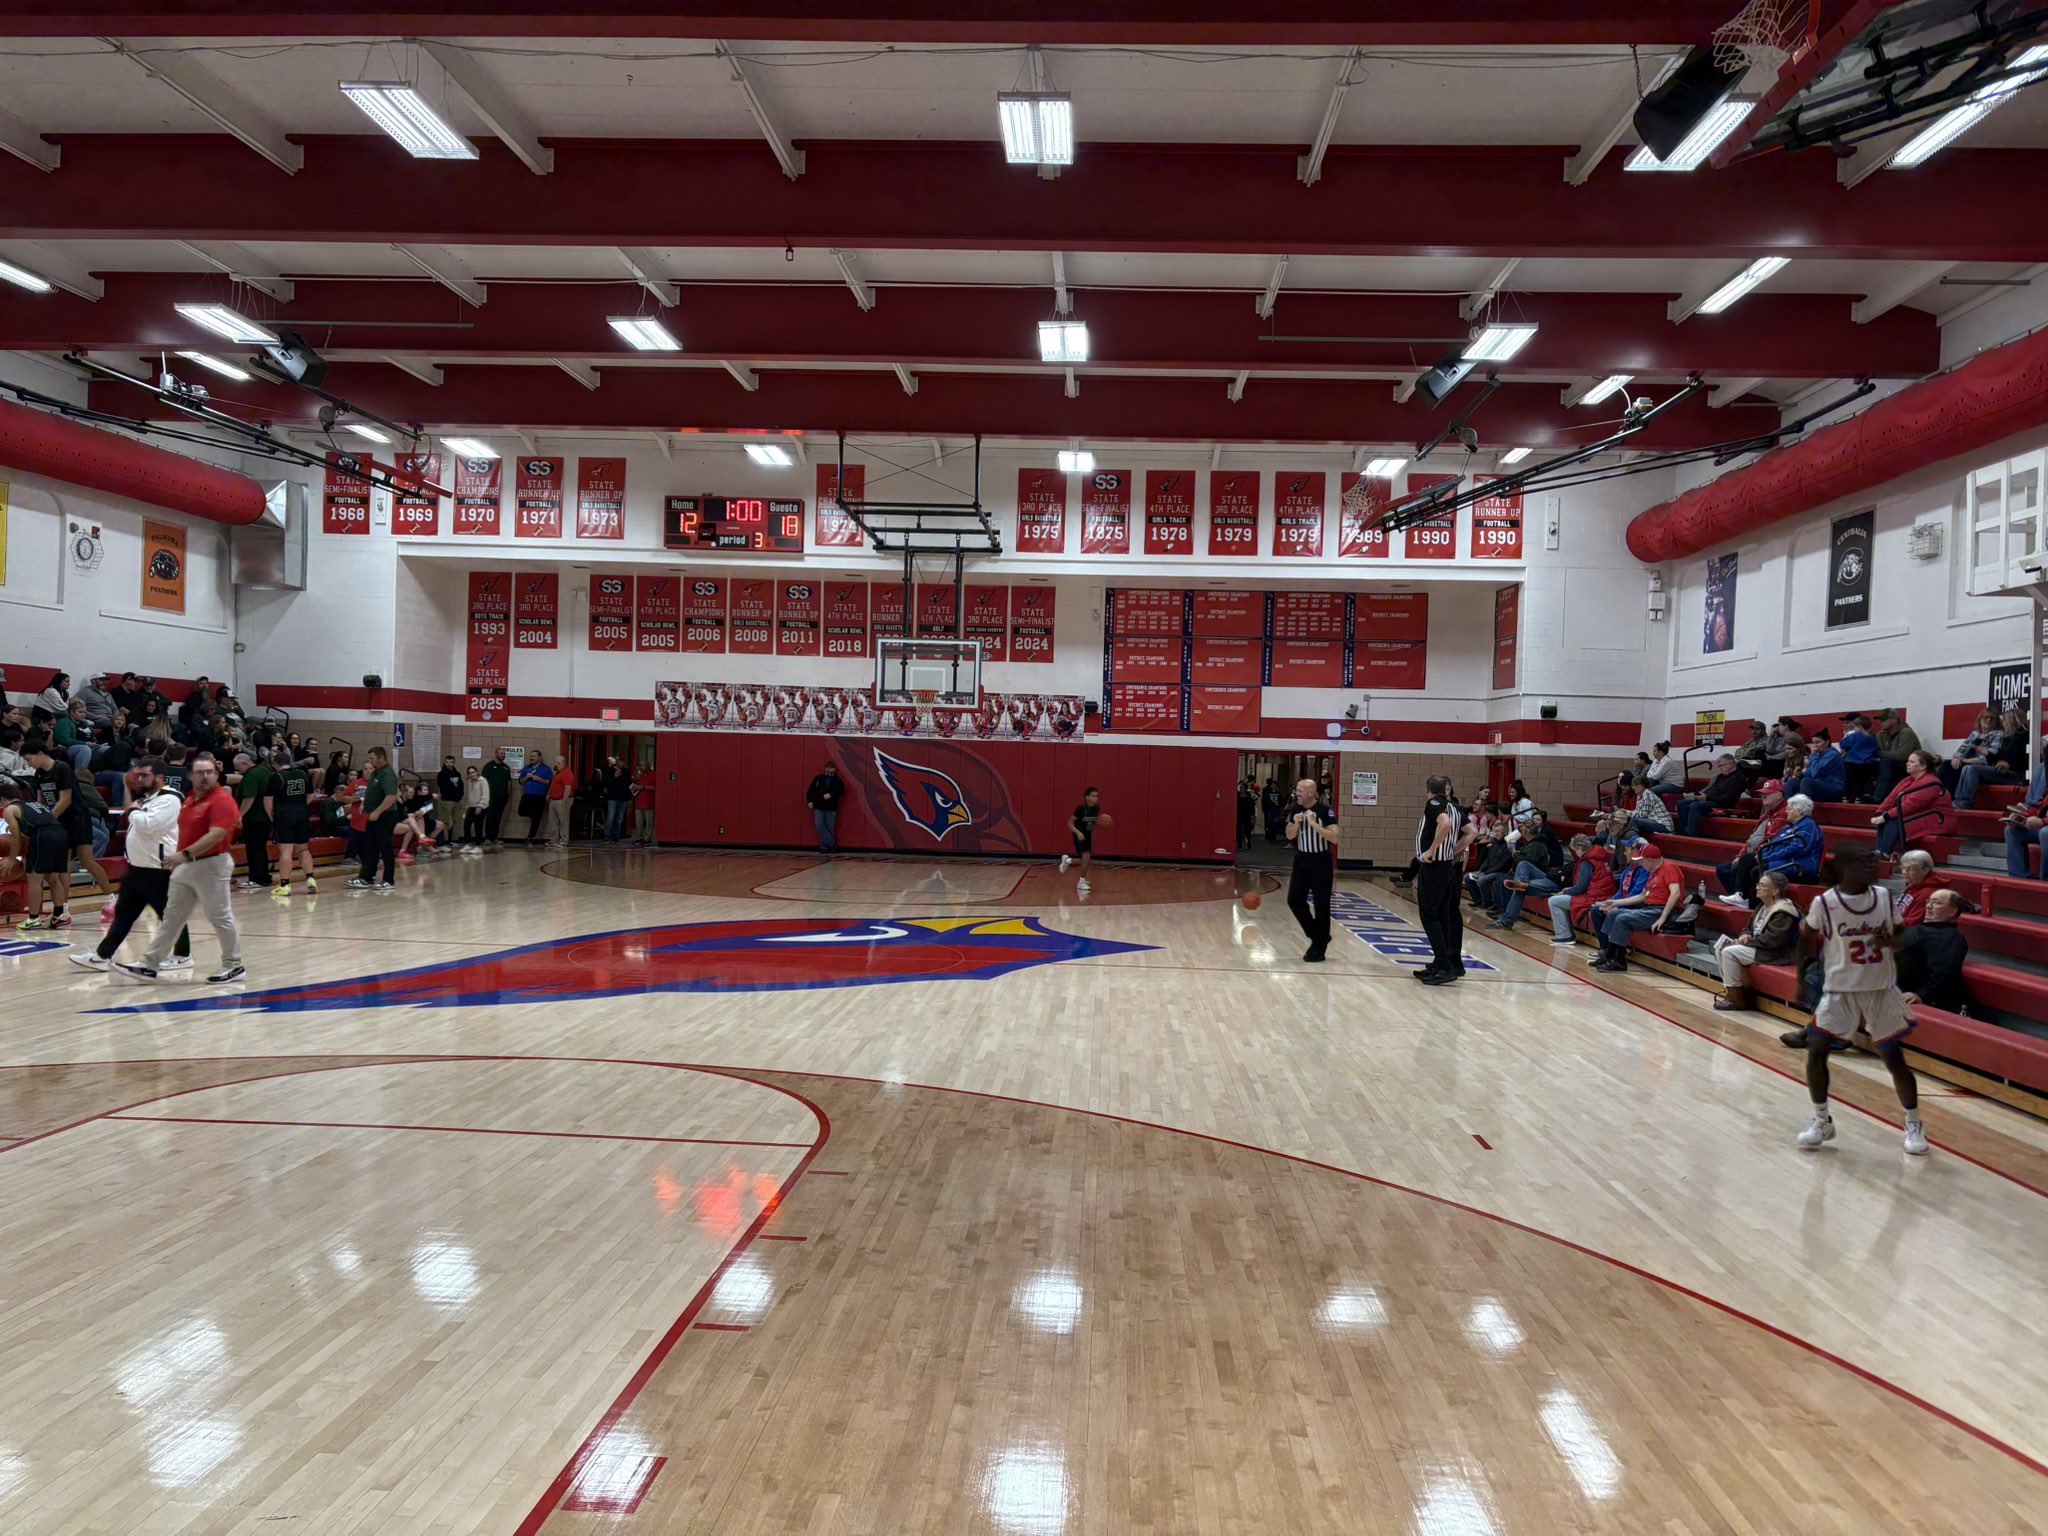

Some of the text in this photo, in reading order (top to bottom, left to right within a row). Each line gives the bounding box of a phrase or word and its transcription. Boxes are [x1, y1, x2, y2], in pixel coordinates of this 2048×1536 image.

[335, 475, 361, 484] STATE
[465, 477, 490, 485] STATE
[527, 480, 552, 488] STATE
[324, 485, 370, 494] SEMI-FINALIST
[589, 481, 614, 489] STATE
[456, 486, 499, 496] CHAMPIONS
[518, 489, 561, 498] RUNNER UP
[580, 490, 624, 499] RUNNER UP
[827, 487, 853, 497] STTE
[1029, 493, 1055, 502] STATE
[1093, 494, 1119, 503] STATE
[1157, 495, 1183, 503] STATE
[1221, 496, 1247, 504] STATE
[1286, 497, 1312, 505] STATE
[671, 500, 694, 509] Home
[769, 502, 798, 513] Guests
[1021, 503, 1061, 512] 3RD PLACE
[1081, 504, 1130, 512] SEMI-FINALIST
[1484, 499, 1511, 507] STATE
[726, 500, 762, 522] 1:00
[1150, 504, 1189, 513] 4TH PLACE
[1215, 505, 1253, 514] 3RD PLACE
[1278, 506, 1320, 515] 4TH PLACE
[1475, 508, 1520, 517] RUNNER UP
[330, 507, 365, 521] 1968
[398, 508, 433, 521] 1969
[460, 508, 494, 521] 1970
[521, 511, 555, 524] 1971
[583, 513, 618, 526] 1973
[679, 512, 697, 534] 12
[781, 515, 799, 537] 18
[823, 518, 858, 533] 1974
[1023, 525, 1059, 538] 1975
[1151, 527, 1187, 541] 1978
[1215, 528, 1252, 542] 1979
[1280, 528, 1317, 542] 1979
[1837, 527, 1867, 546] CENTRALIA
[151, 533, 179, 548] PALMYRA
[719, 535, 746, 546] period
[754, 532, 764, 548] 3
[1344, 530, 1383, 544] 989
[1413, 531, 1450, 545] 1990
[1479, 531, 1516, 544] 1990
[788, 585, 810, 599] SS
[524, 595, 548, 603] STATE
[600, 597, 623, 605] STATE
[693, 600, 717, 608] STATE
[1834, 593, 1863, 607] PANTHERS
[472, 602, 507, 611] 3RD PLACE
[518, 604, 554, 612] 3RD PLACE
[589, 606, 633, 614] SEMI-FINALIST
[640, 607, 653, 615] 4TH
[684, 608, 724, 617] CHAMPIONS
[732, 609, 760, 617] RUNNER
[778, 610, 819, 619] RUNNER UP
[842, 613, 863, 621] PLACE
[974, 608, 998, 616] STATE
[1021, 608, 1044, 616] STATE
[921, 614, 932, 622] 4TH
[967, 616, 1003, 624] 3RD PLACE
[1010, 617, 1055, 625] SEMI-FINALIST
[473, 623, 505, 635] 1993
[594, 626, 627, 638] 2005
[687, 628, 720, 640] 2006
[519, 631, 552, 643] 2004
[641, 634, 674, 647] 2005
[734, 629, 768, 642] 2008
[781, 631, 814, 643] 2011
[828, 640, 862, 652] 2018
[968, 635, 1001, 649] 2024
[1015, 637, 1049, 650] 2024
[469, 677, 506, 686] 2ND PLACE
[1993, 672, 2029, 701] HOME
[470, 697, 504, 710] 2025
[2001, 698, 2019, 713] FANS
[287, 778, 306, 796] 23
[1848, 939, 1884, 965] 23
